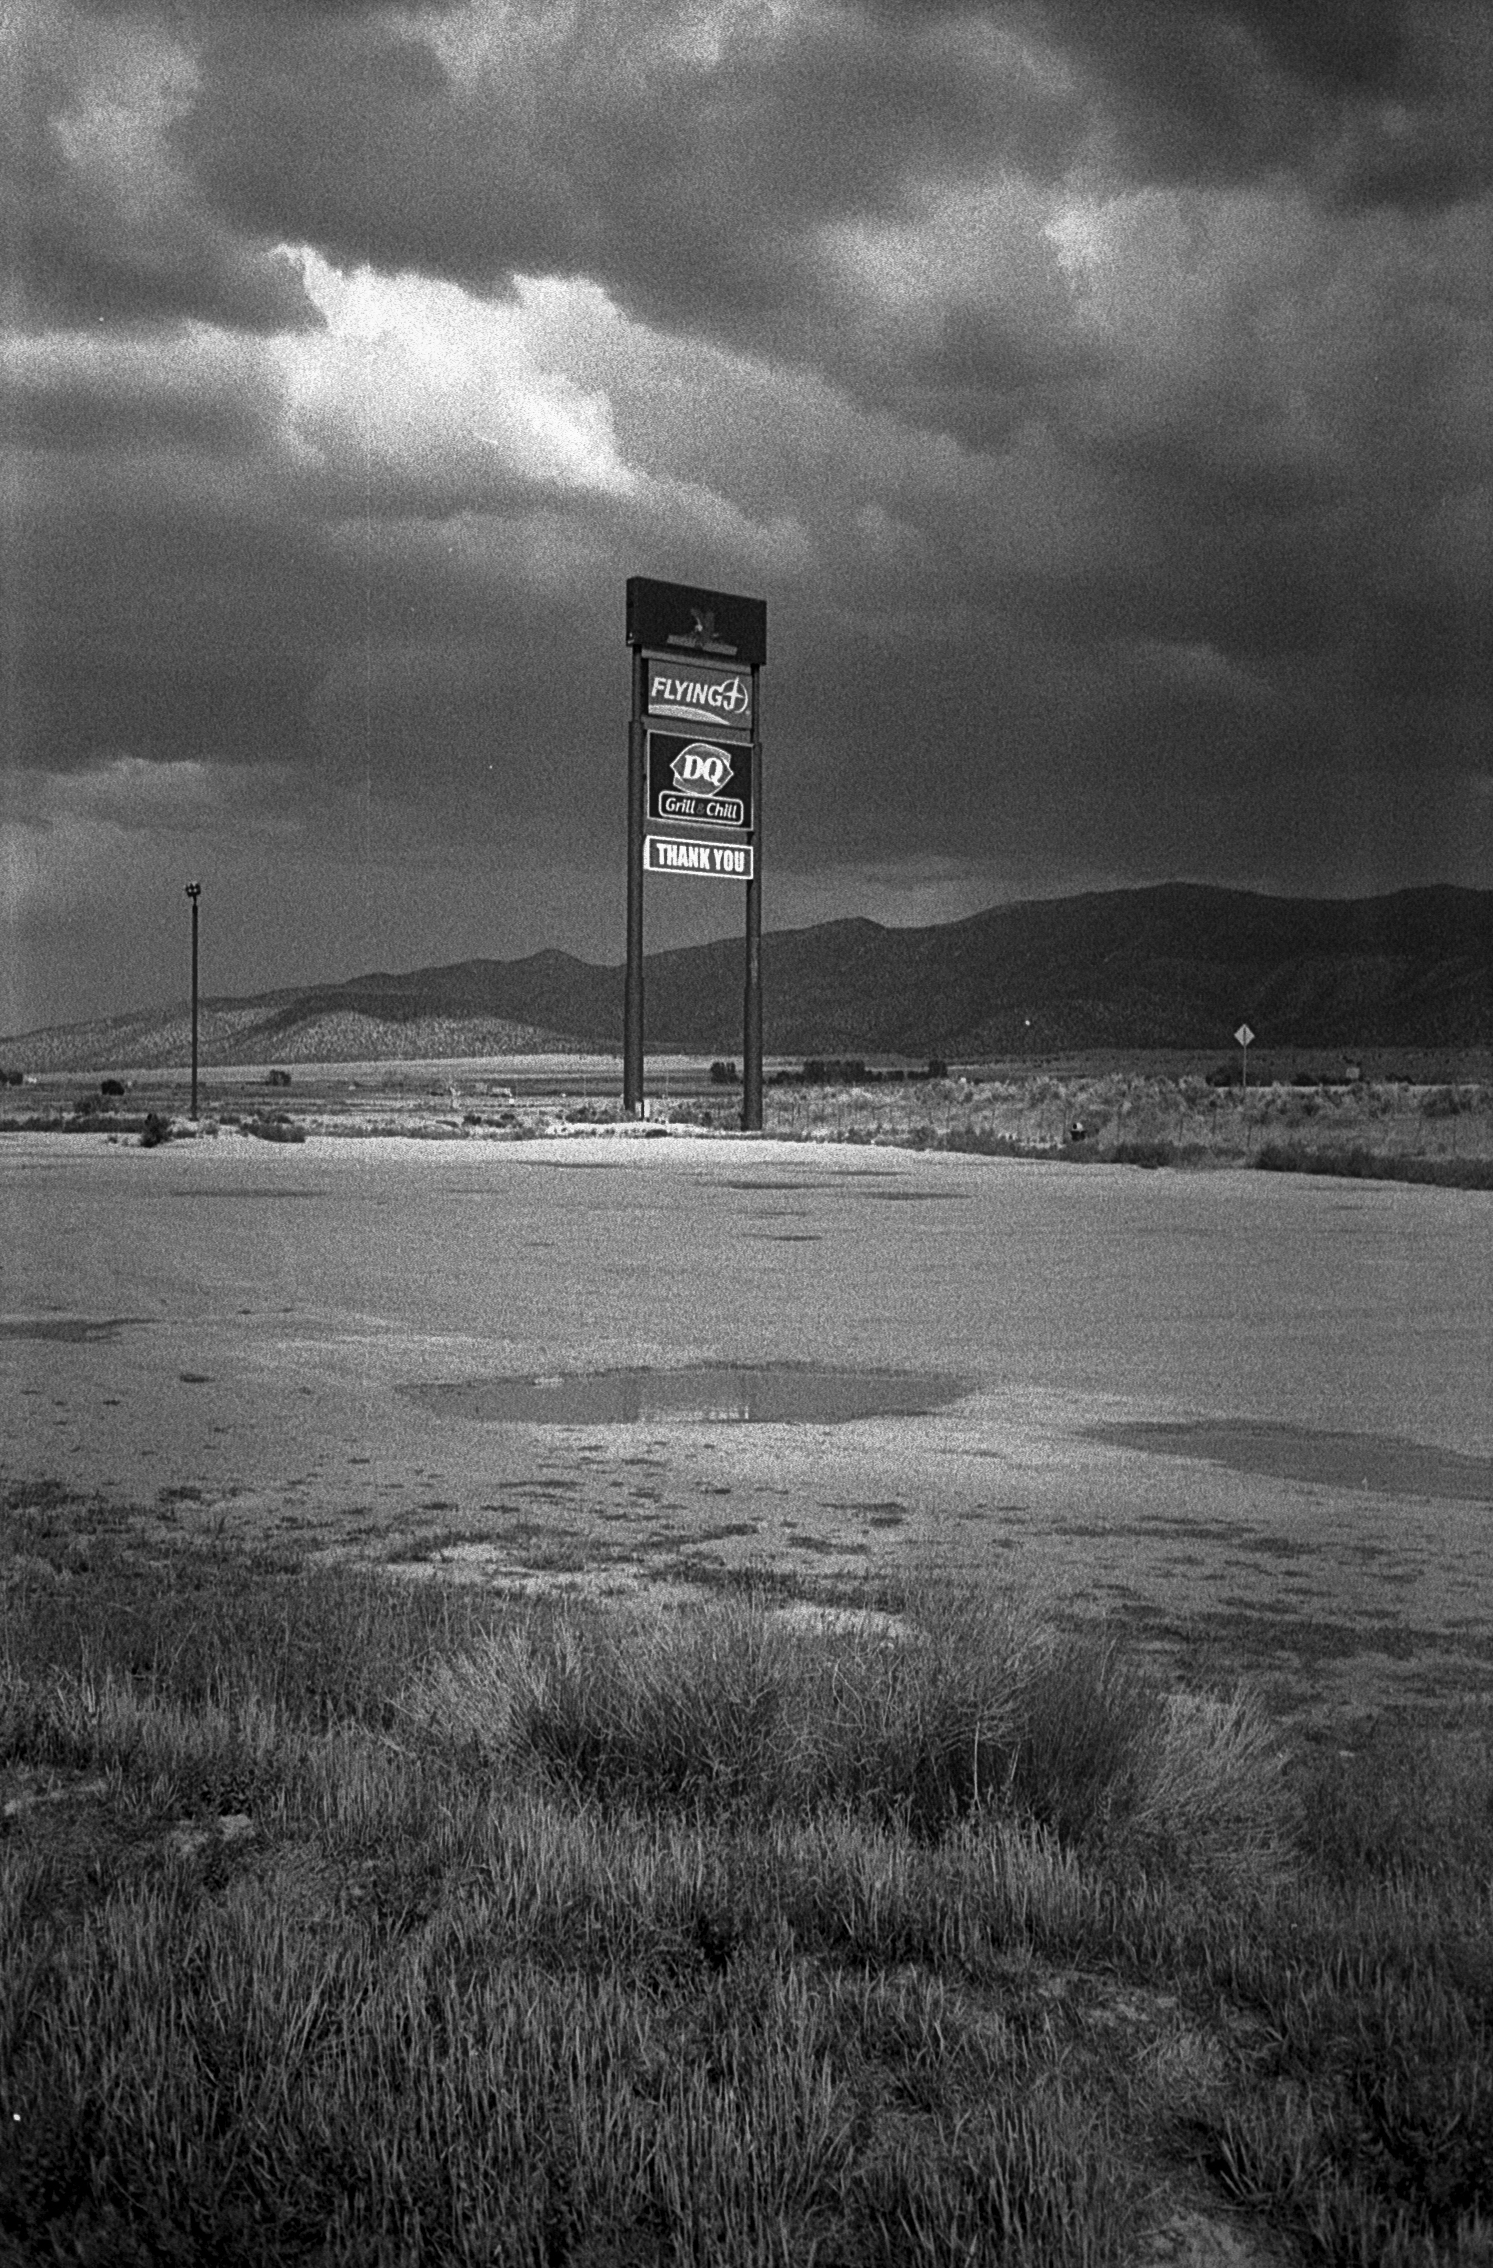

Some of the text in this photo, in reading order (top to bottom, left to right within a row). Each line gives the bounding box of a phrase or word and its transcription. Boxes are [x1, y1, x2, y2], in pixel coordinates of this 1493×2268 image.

[683, 754, 724, 787] DQ
[665, 797, 696, 815] Grill
[706, 802, 738, 819] Chill
[656, 843, 745, 872] THANK YOU
